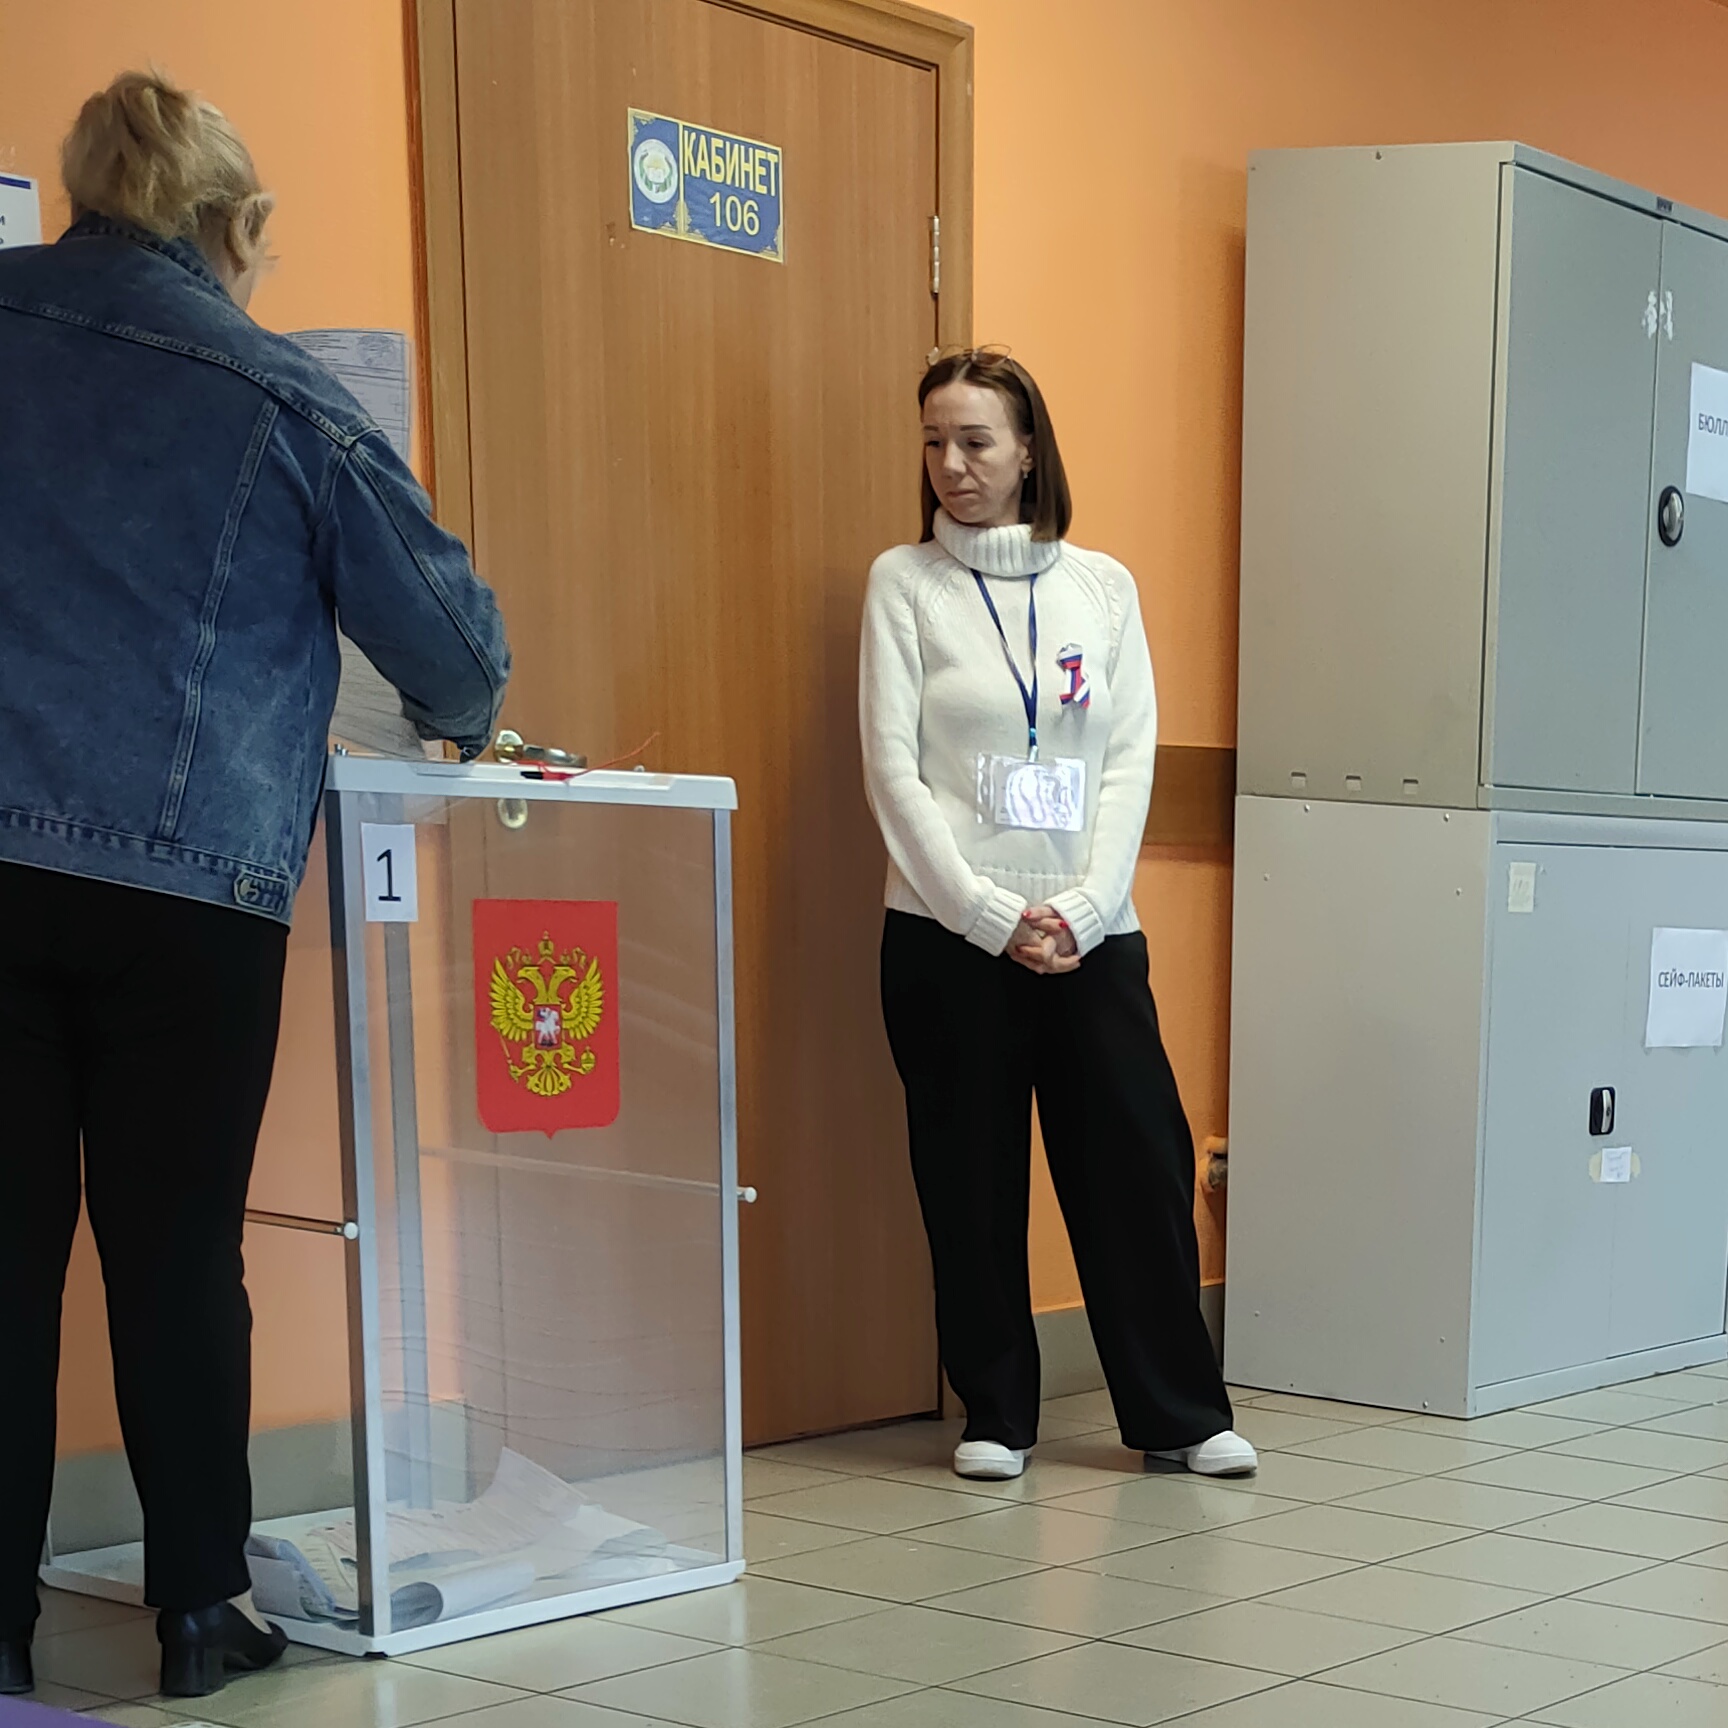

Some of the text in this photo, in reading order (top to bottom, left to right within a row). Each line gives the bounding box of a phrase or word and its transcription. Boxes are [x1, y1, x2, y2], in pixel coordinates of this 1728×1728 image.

[684, 130, 778, 196] КАБИНЕТ
[709, 192, 760, 236] 106
[377, 849, 401, 902] 1
[1658, 968, 1724, 988] СЕЙФ-ПАКЕТЫ
